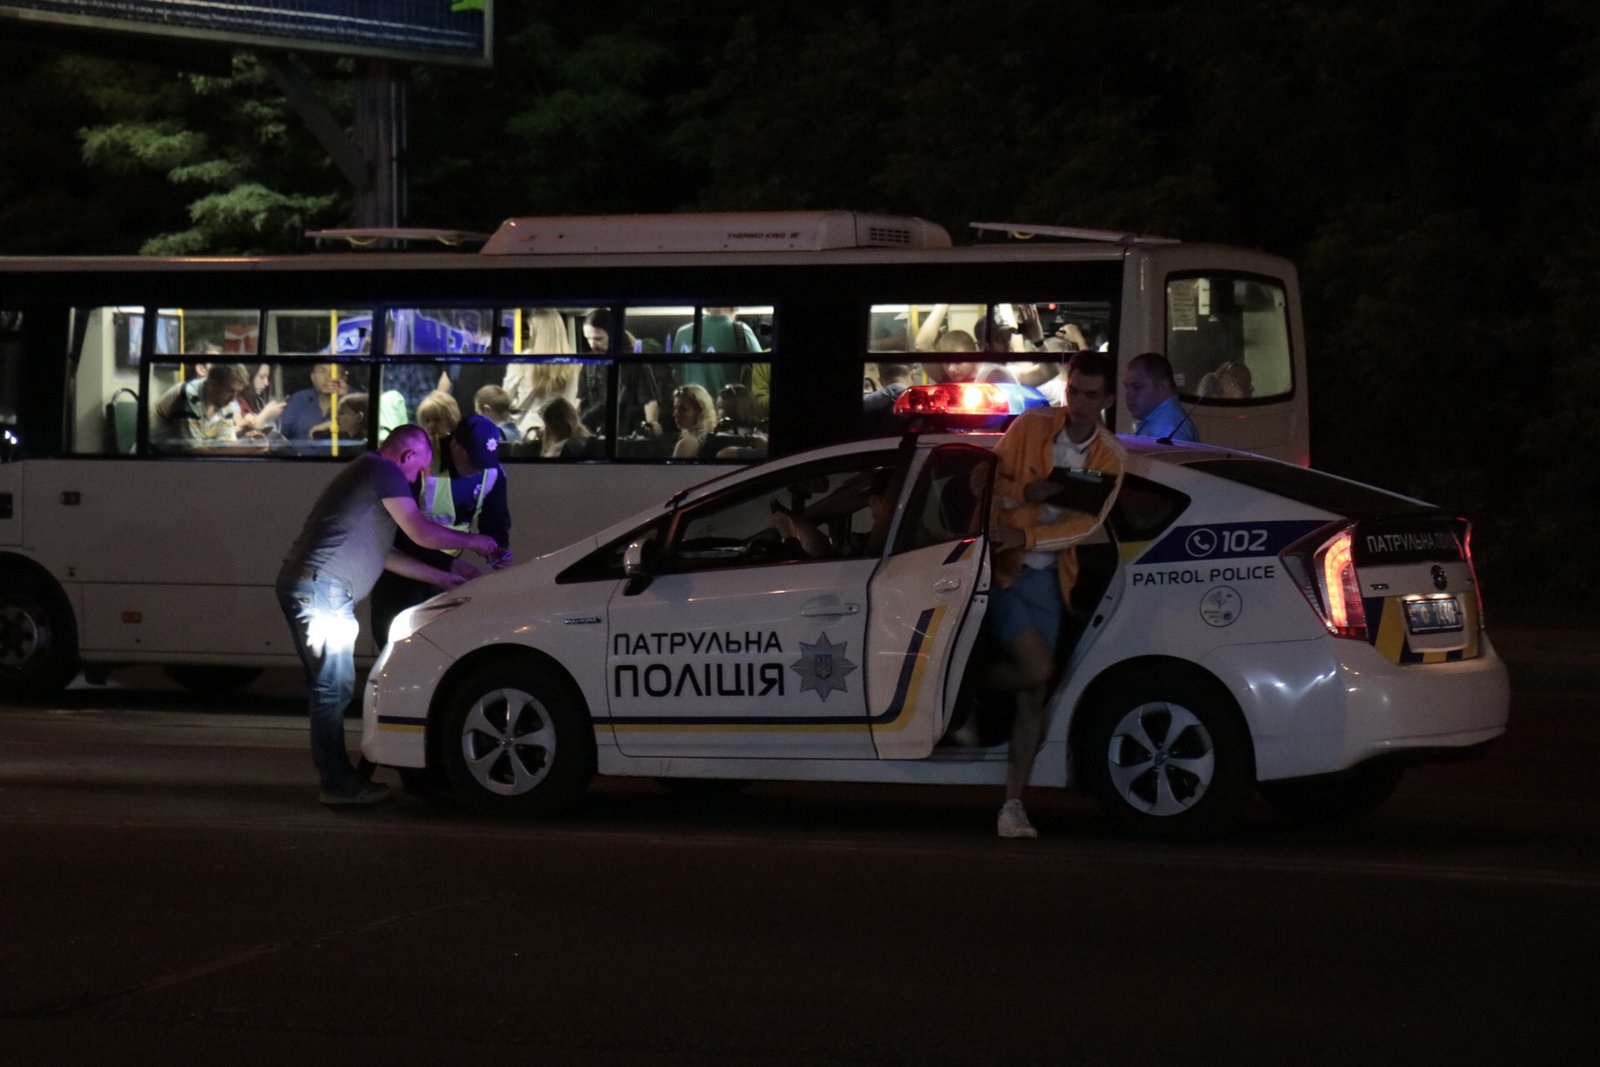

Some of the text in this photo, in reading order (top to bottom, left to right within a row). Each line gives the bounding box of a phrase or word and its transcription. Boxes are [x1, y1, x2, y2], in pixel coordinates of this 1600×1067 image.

[1221, 529, 1268, 553] 102
[1365, 532, 1436, 553] ПАТРУЛЬНА
[1132, 565, 1275, 586] PATROL POLICE
[613, 631, 784, 655] ПАТРУЛЬНА
[614, 662, 786, 698] ПОЛІЦІЯ
